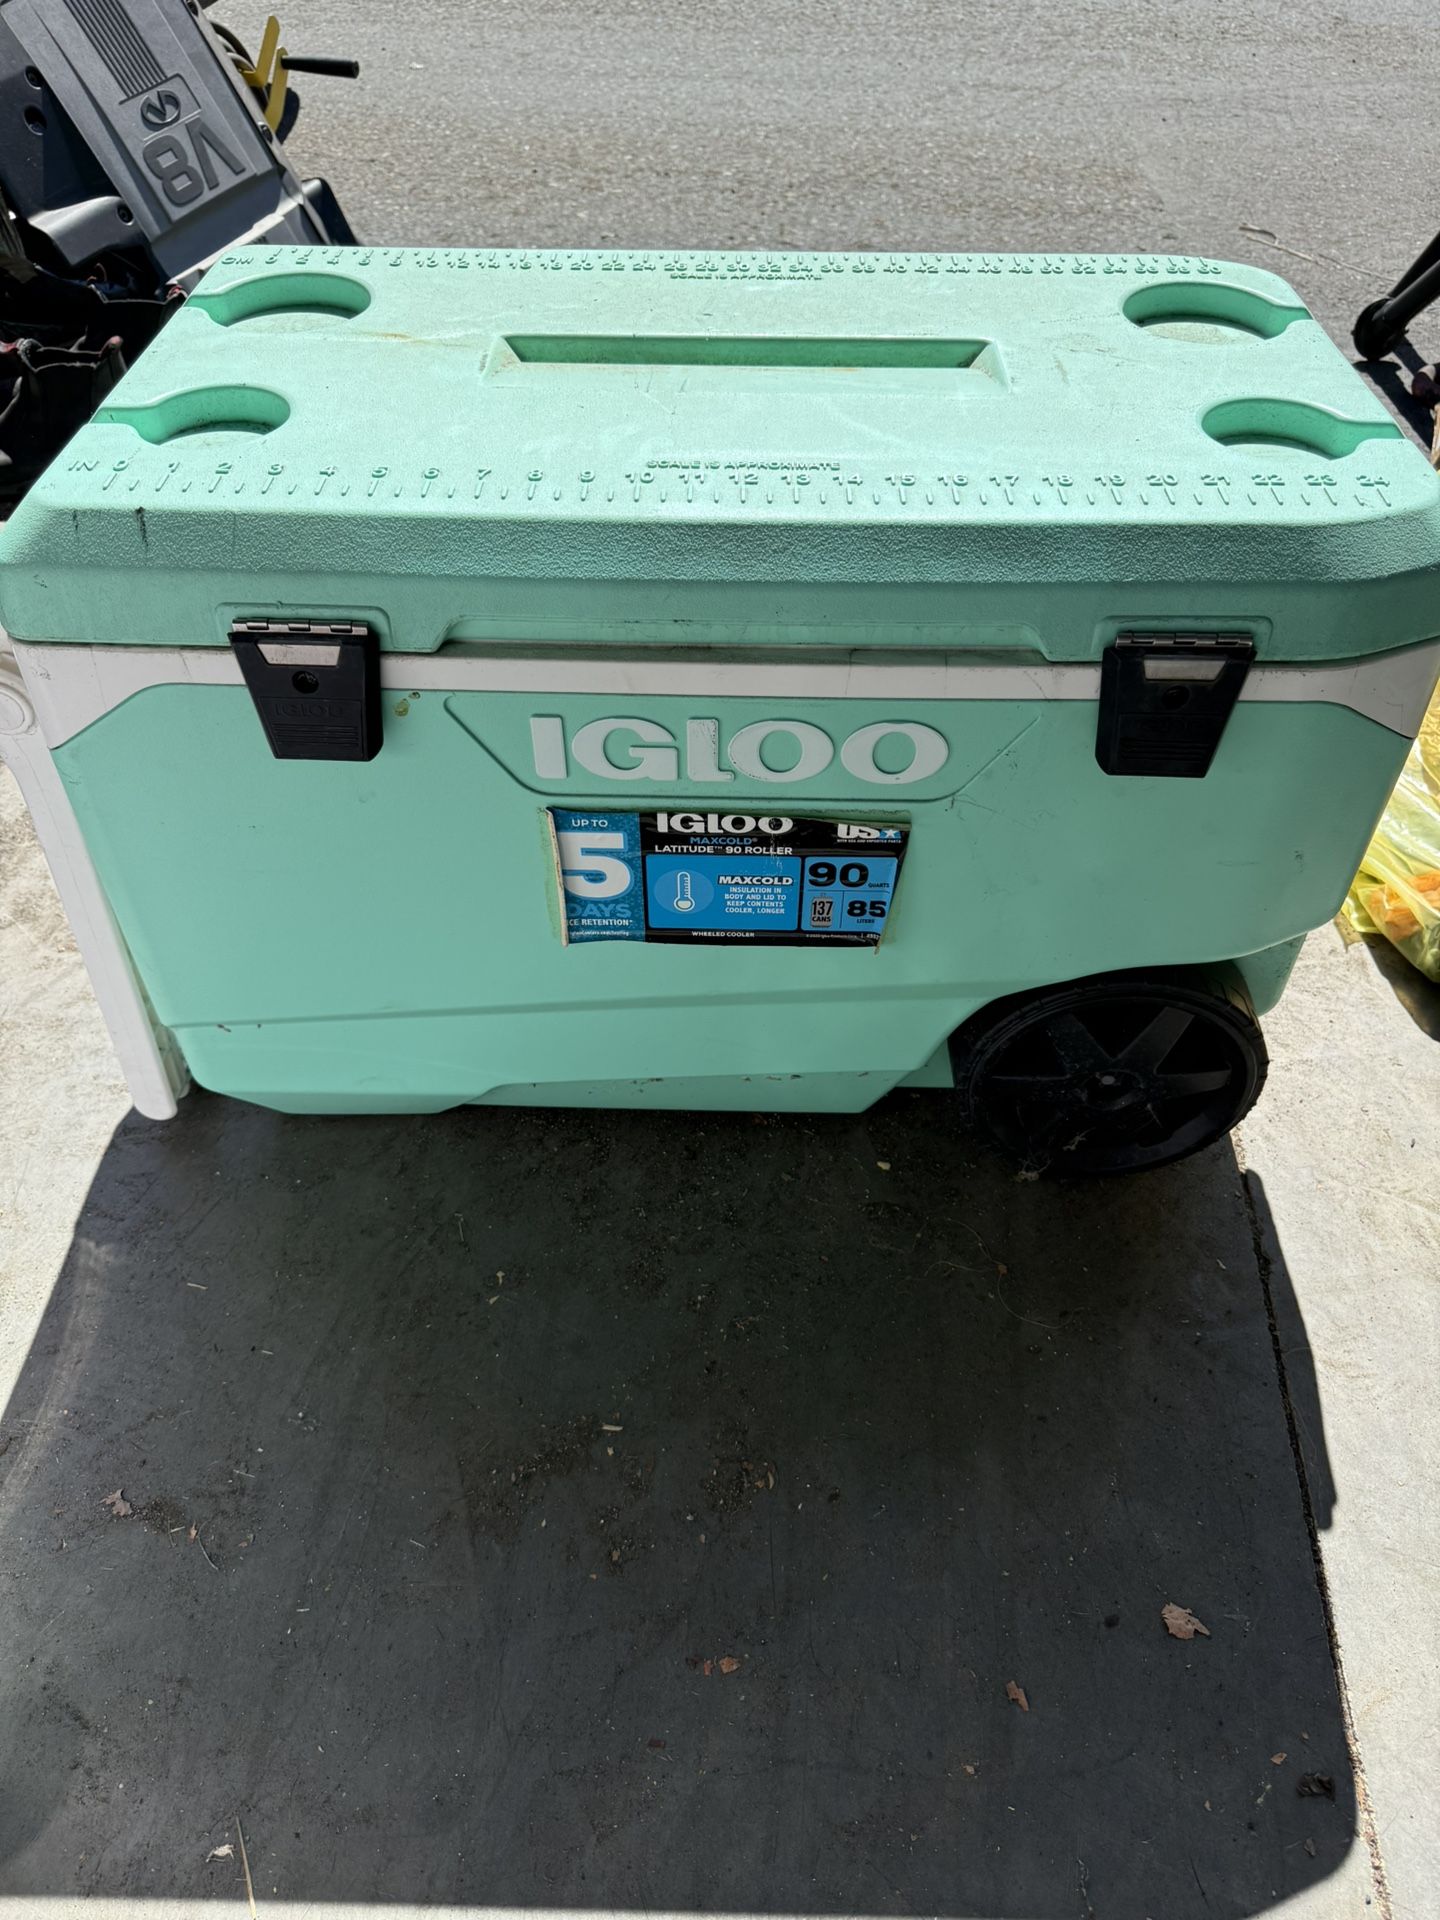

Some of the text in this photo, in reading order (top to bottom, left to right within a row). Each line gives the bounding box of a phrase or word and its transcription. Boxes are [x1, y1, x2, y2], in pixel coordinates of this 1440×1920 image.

[142, 120, 246, 208] V8
[68, 459, 1391, 488] IN 0 1 2 3 4 5 6 7 8 9 10 11 12 13 14 15 16 17 18 19 20 21 22 23 24
[647, 460, 841, 471] SCALE IS APPROXIMATE
[530, 713, 950, 785] IGLOO
[571, 819, 609, 828] UP TO
[656, 811, 794, 834] IGLOO
[725, 846, 743, 855] 90
[745, 847, 793, 856] ROLLER
[558, 832, 632, 899] 5
[718, 876, 793, 885] MAXCOLD
[808, 861, 869, 888] 90
[567, 903, 632, 918] DAYS
[725, 907, 755, 915] COOLER,
[812, 900, 834, 916] 137
[847, 900, 887, 919] 85
